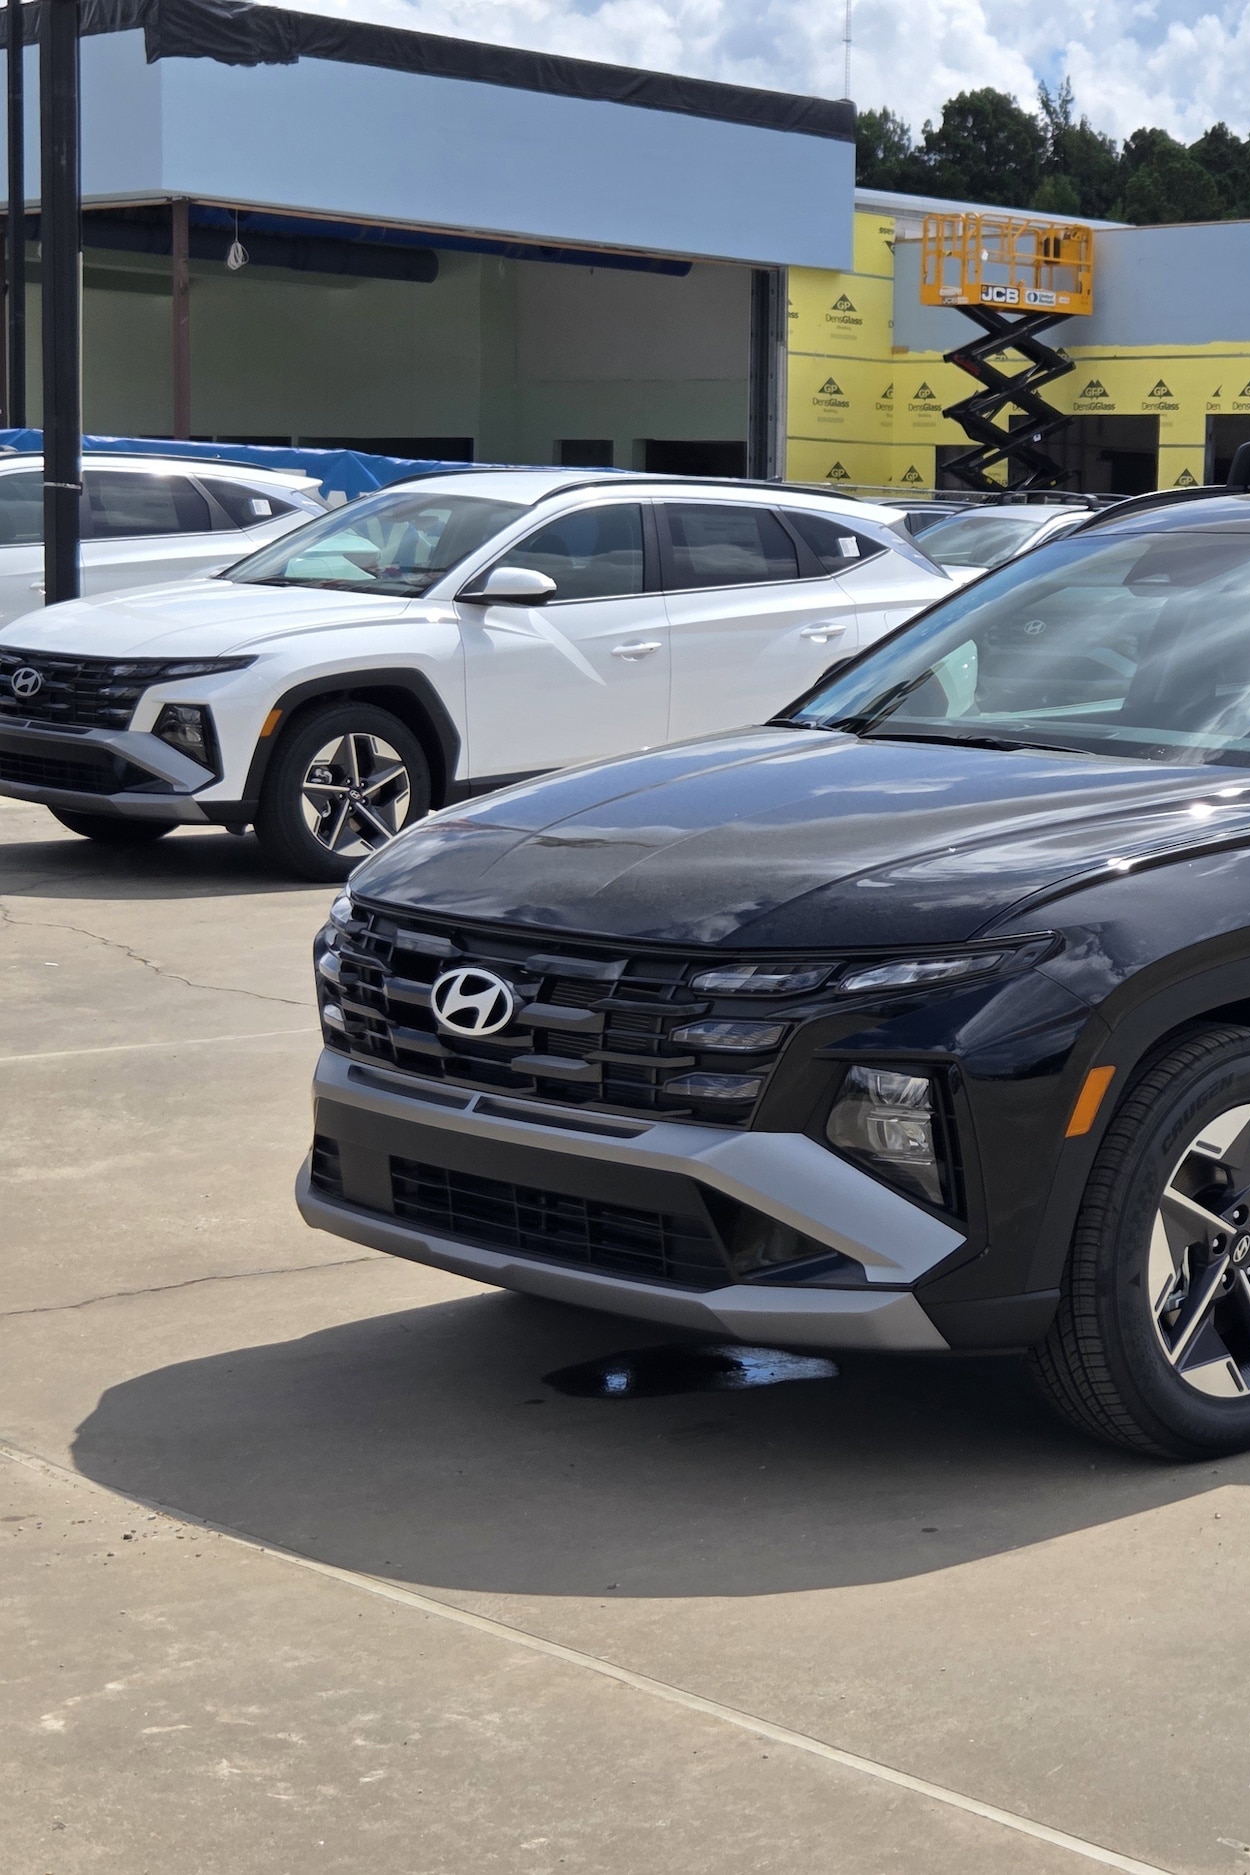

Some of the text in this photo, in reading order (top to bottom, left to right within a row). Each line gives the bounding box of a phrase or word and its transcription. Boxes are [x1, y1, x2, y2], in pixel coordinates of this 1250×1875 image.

[981, 286, 1019, 304] JCB
[836, 300, 850, 310] GP
[825, 313, 863, 326] DensGlass
[823, 383, 838, 393] GP
[1152, 386, 1168, 396] GP
[918, 389, 931, 398] GP
[812, 397, 850, 408] DensGlass
[908, 403, 942, 411] DensGlass
[1141, 402, 1180, 411] DensGlass
[831, 469, 845, 478] GP
[905, 472, 919, 481] GP
